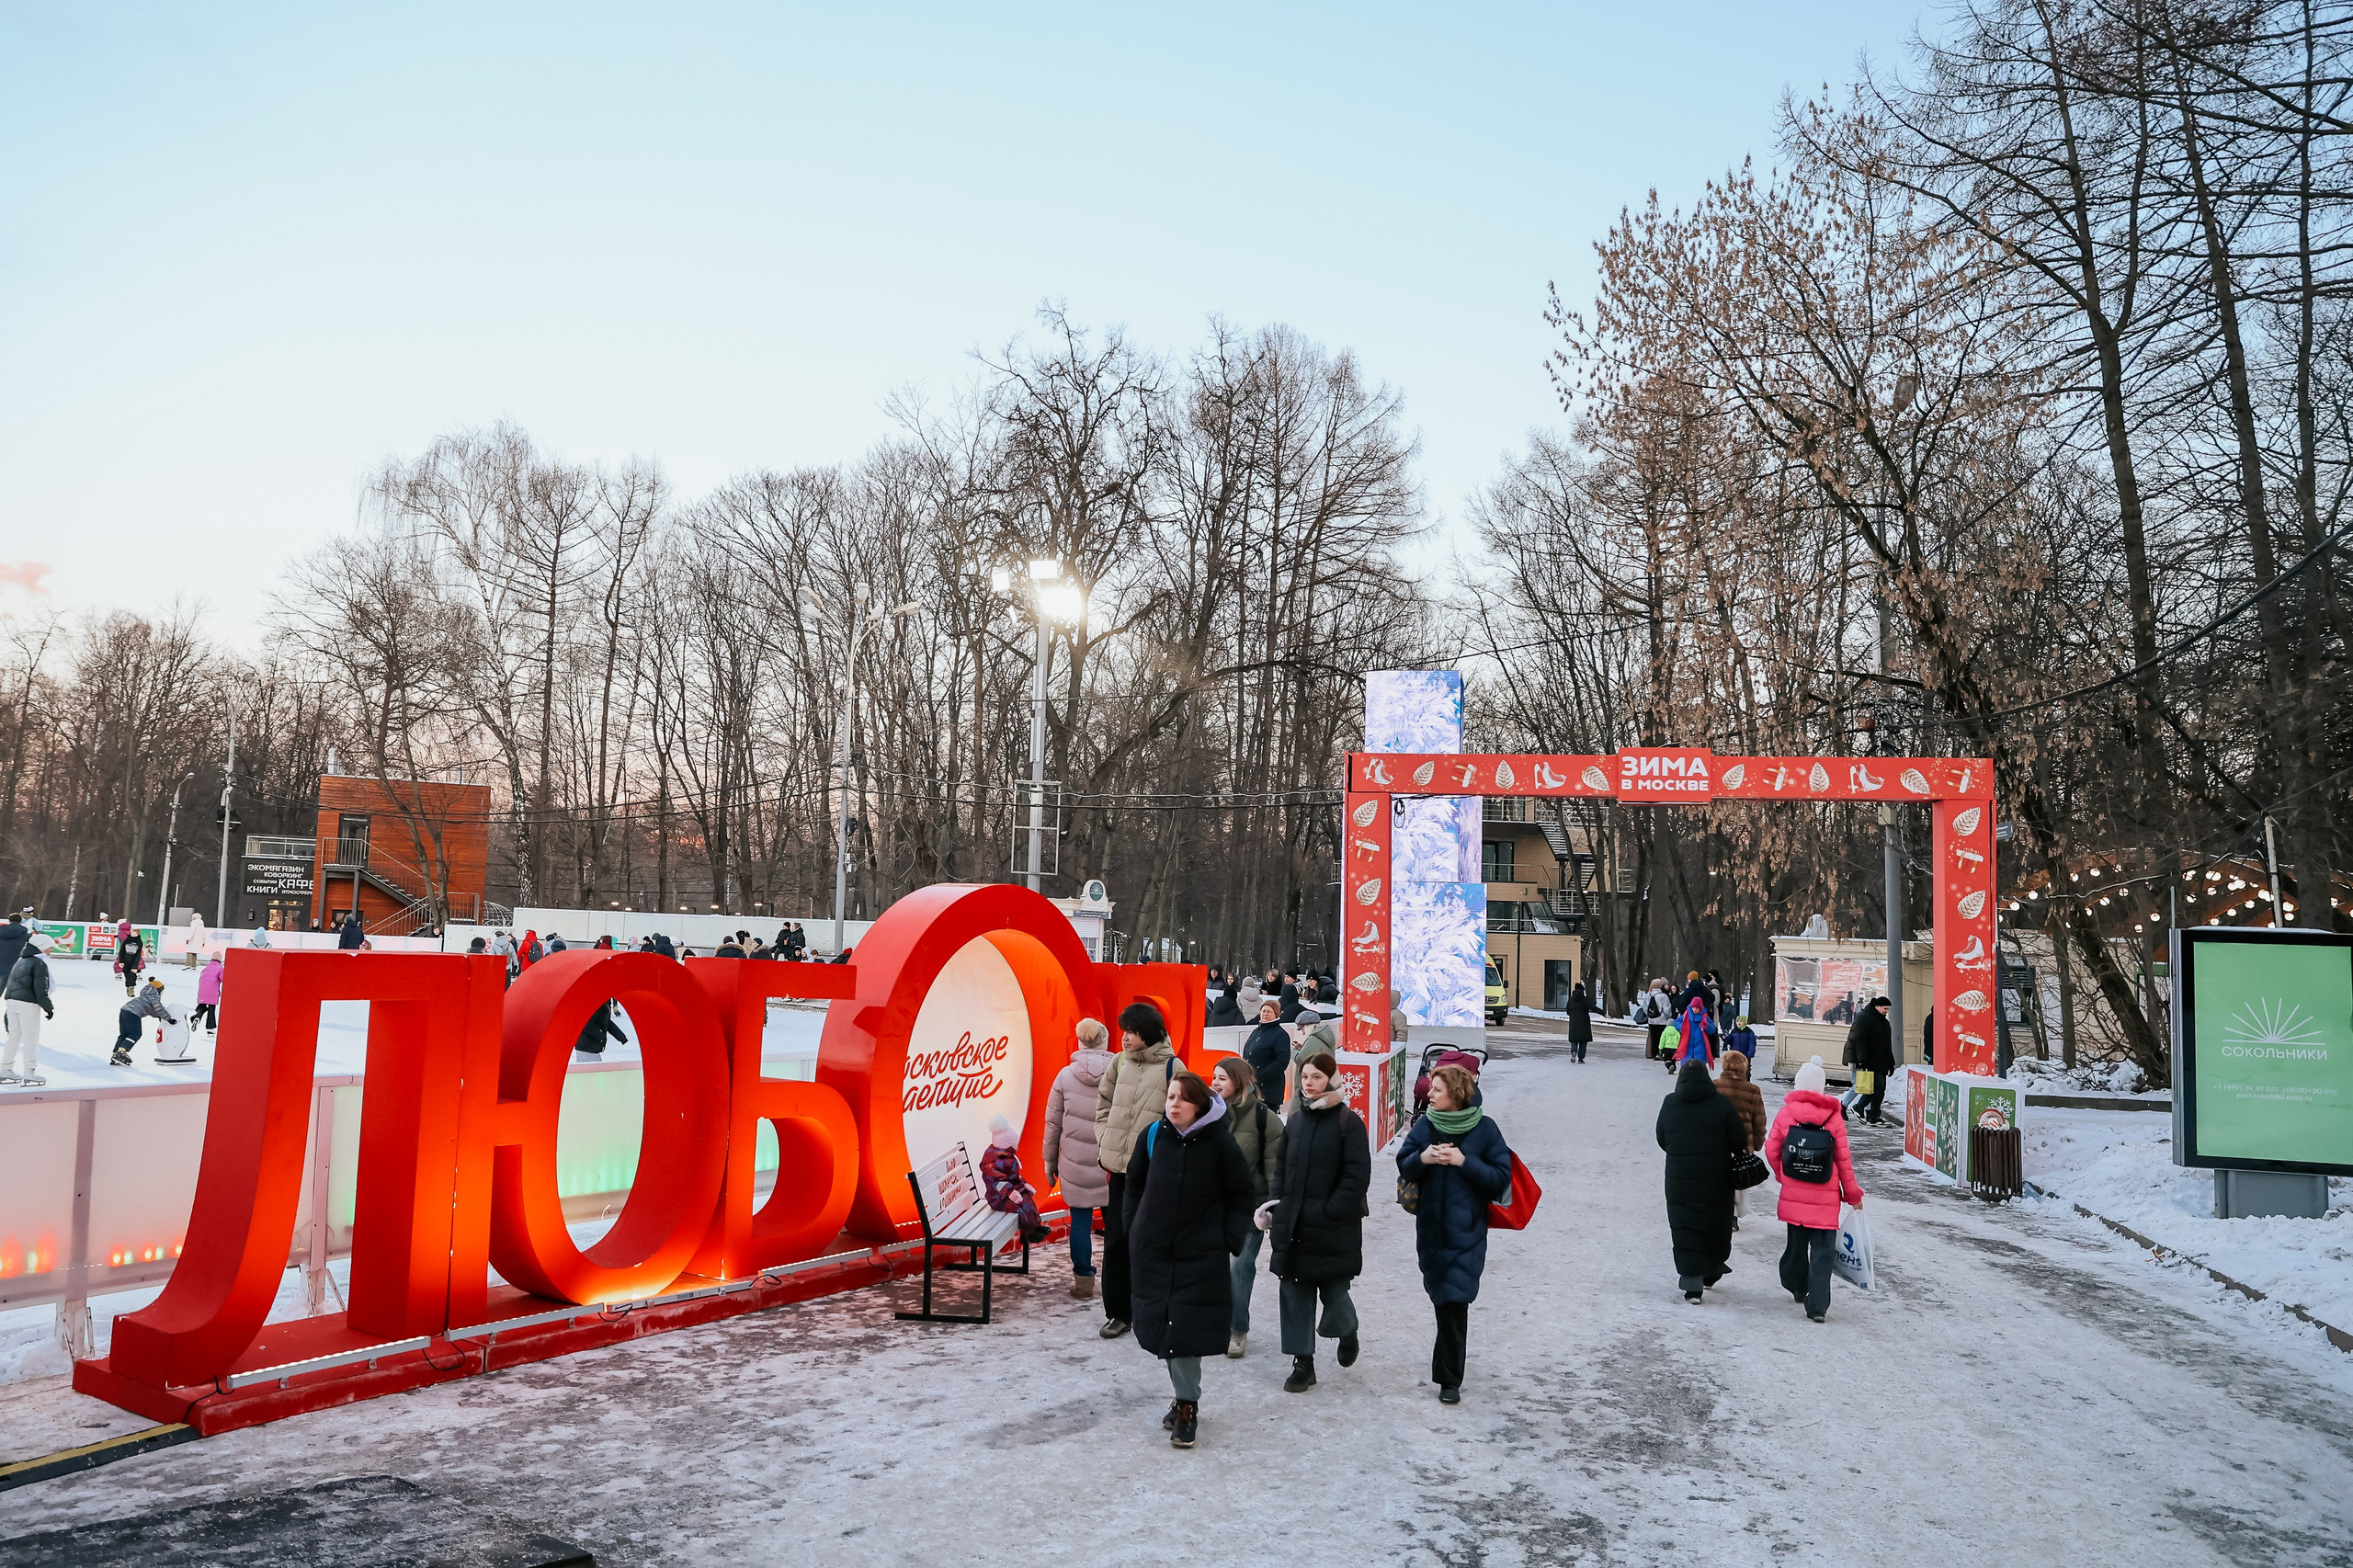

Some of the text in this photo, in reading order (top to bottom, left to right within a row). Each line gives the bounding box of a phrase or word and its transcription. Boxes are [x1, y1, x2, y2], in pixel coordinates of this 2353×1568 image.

[1621, 756, 1709, 777] ЗИМА
[1621, 779, 1709, 790] В МОСКВЕ
[247, 864, 304, 872] ЭКОМАГАЗИН
[2222, 1046, 2327, 1061] СОКОЛЬНИКИ
